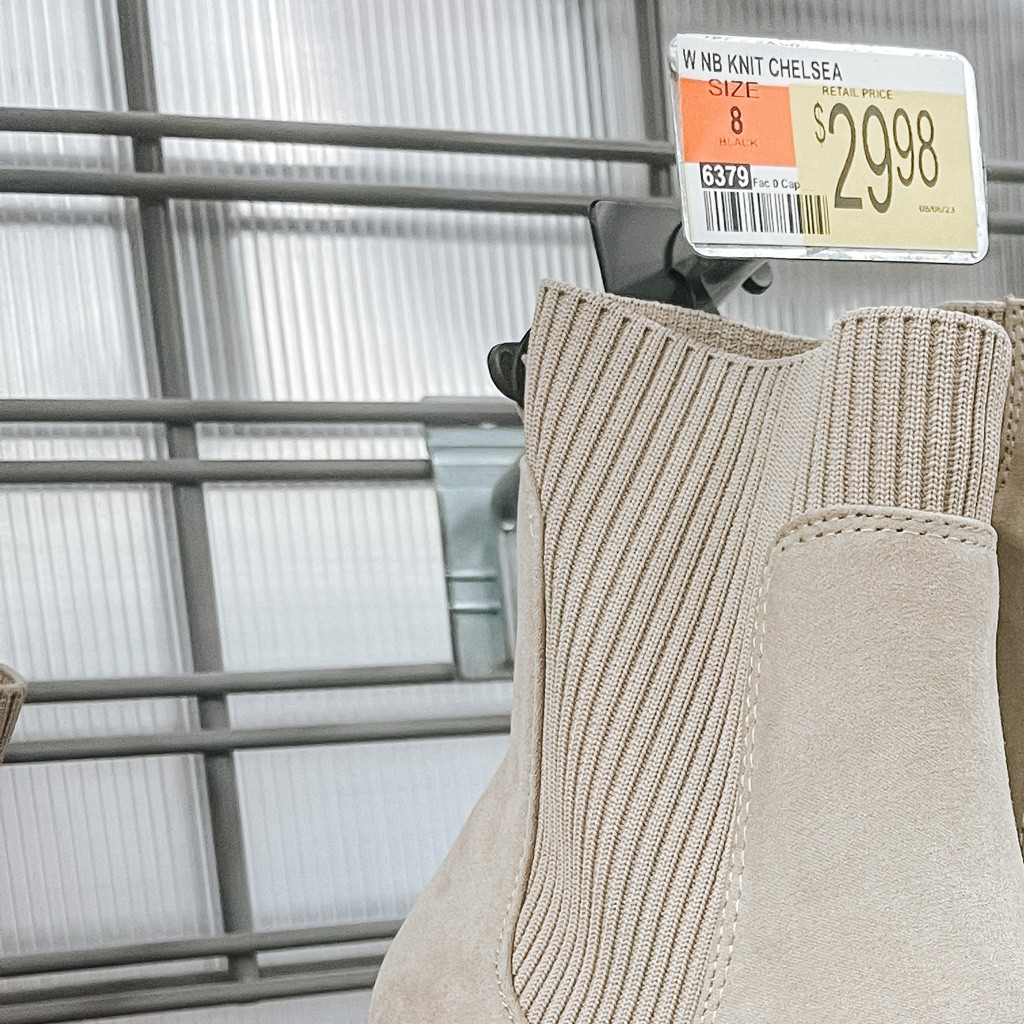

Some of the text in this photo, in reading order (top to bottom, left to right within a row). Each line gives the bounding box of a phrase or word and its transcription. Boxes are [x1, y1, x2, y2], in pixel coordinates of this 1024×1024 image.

[682, 49, 843, 81] W NB KNIT CHELSEA
[708, 79, 760, 99] SIZE
[821, 86, 893, 100] RETAIL PRICE
[730, 106, 744, 135] 8
[718, 137, 759, 149] BLACK
[701, 164, 750, 187] 6379
[752, 177, 770, 188] Fac
[781, 178, 801, 191] Cap
